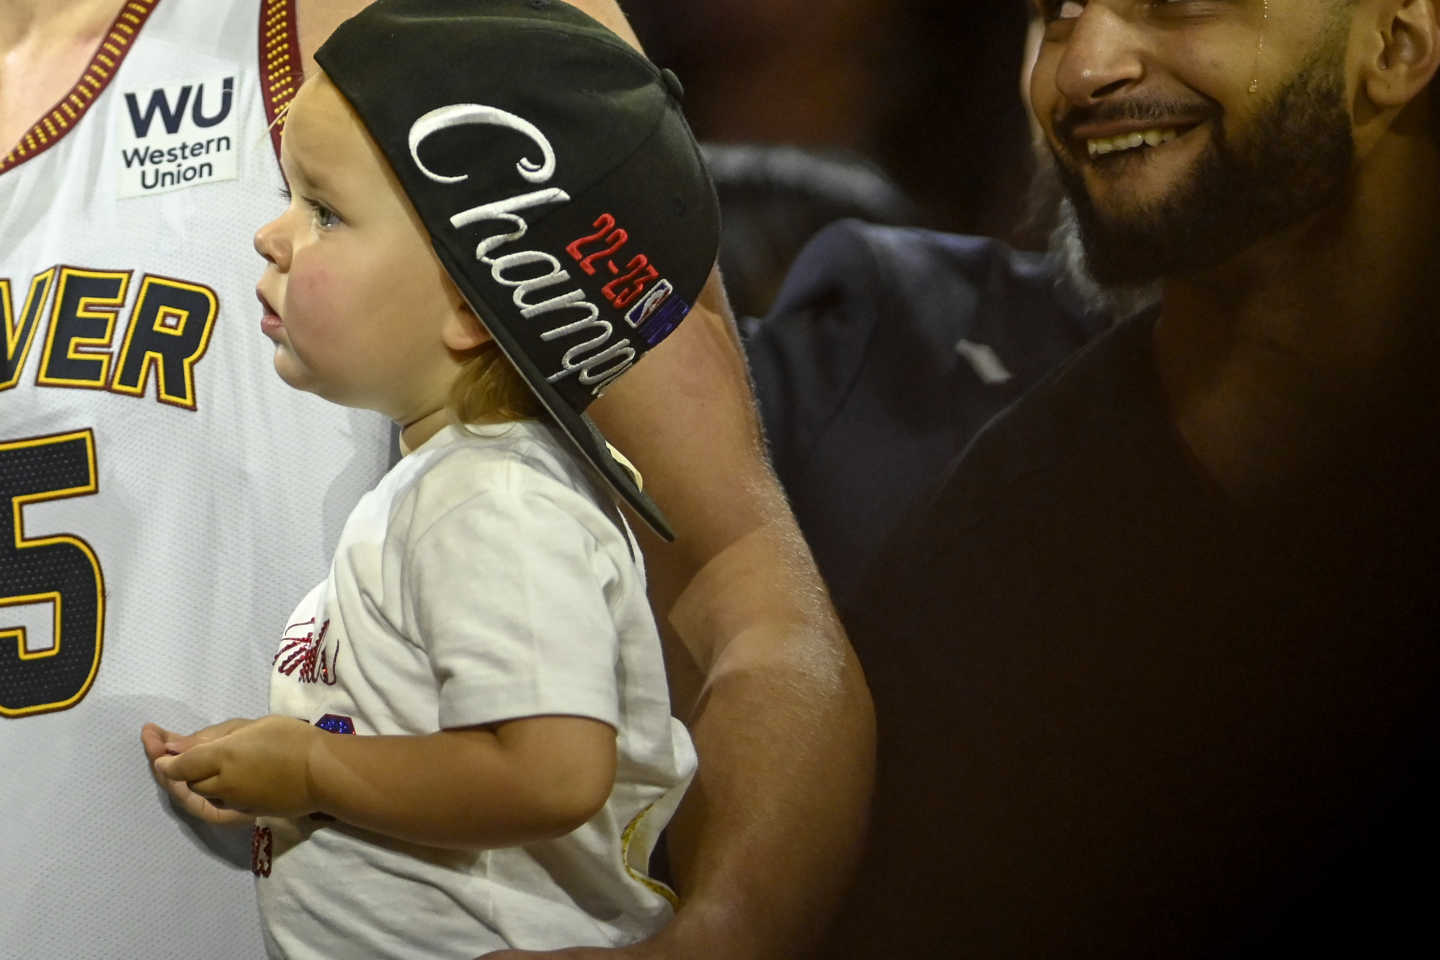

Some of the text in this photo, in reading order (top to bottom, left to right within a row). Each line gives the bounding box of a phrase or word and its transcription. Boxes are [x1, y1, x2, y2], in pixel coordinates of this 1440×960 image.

[124, 76, 235, 139] WU
[122, 135, 231, 169] Western
[141, 162, 213, 190] Union
[408, 103, 636, 398] Champ
[565, 213, 659, 309] 22-23
